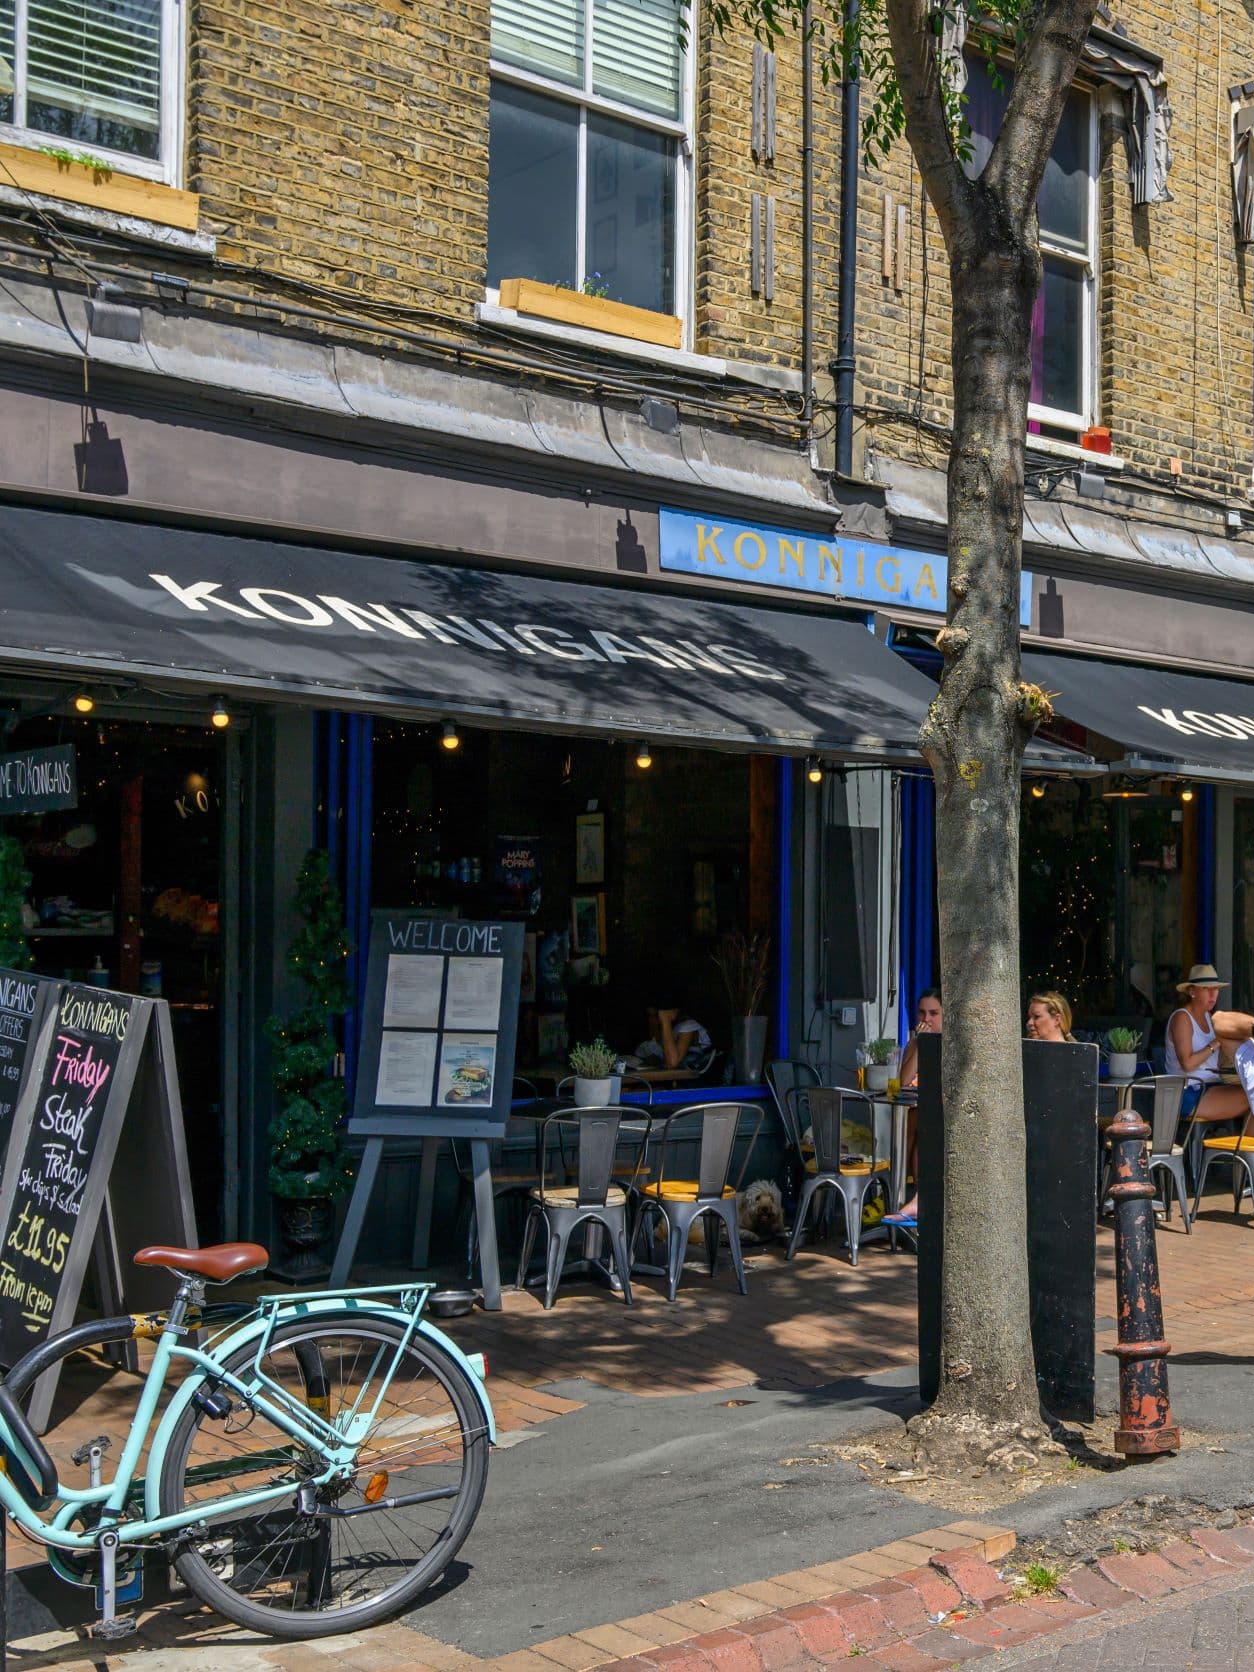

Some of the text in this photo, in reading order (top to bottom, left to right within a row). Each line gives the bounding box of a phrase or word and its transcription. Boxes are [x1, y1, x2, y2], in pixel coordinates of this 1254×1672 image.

[695, 523, 938, 599] KONNIGA
[148, 573, 788, 681] KONNIGANS
[388, 921, 503, 953] WELCOME
[60, 993, 130, 1041] KONNIGANS
